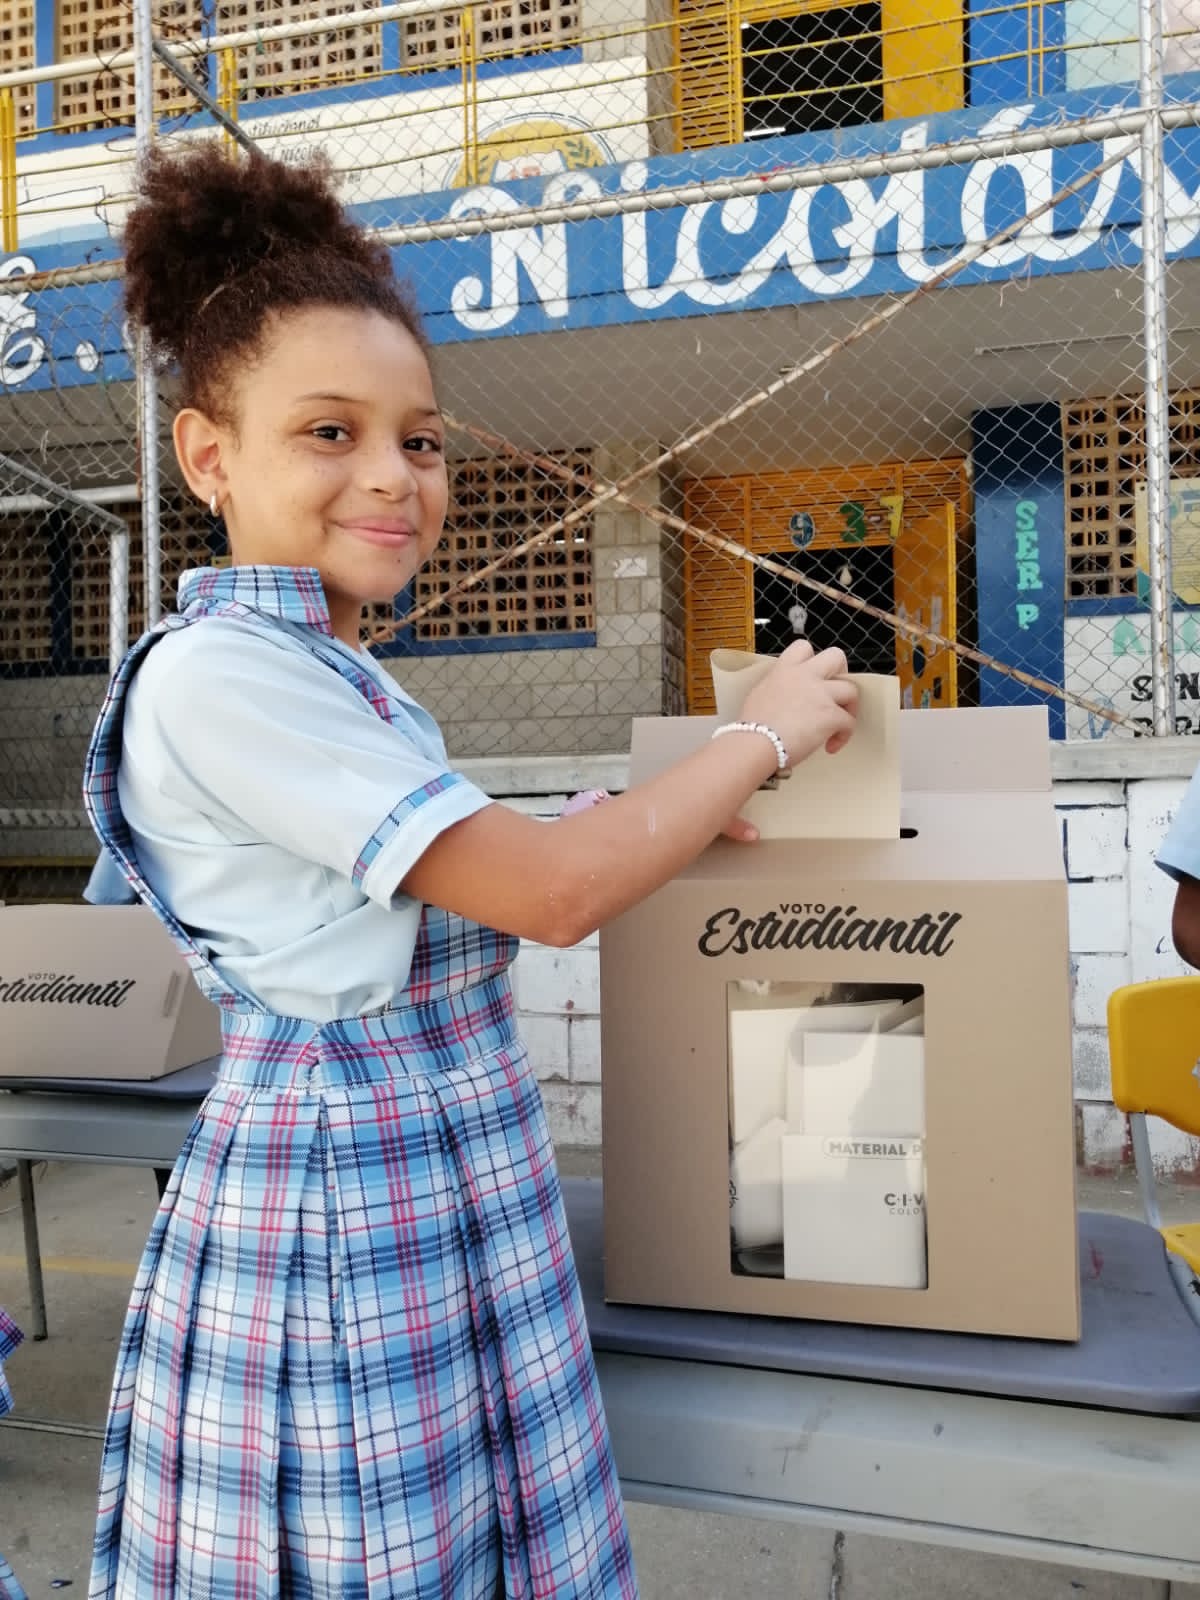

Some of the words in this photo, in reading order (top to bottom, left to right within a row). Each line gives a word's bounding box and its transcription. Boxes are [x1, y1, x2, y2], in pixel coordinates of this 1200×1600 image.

[789, 511, 816, 548] 9
[779, 903, 826, 914] VOTO
[698, 905, 963, 957] Estudiantil
[0, 975, 136, 1008] studiantil
[829, 1142, 907, 1156] MATERIAL
